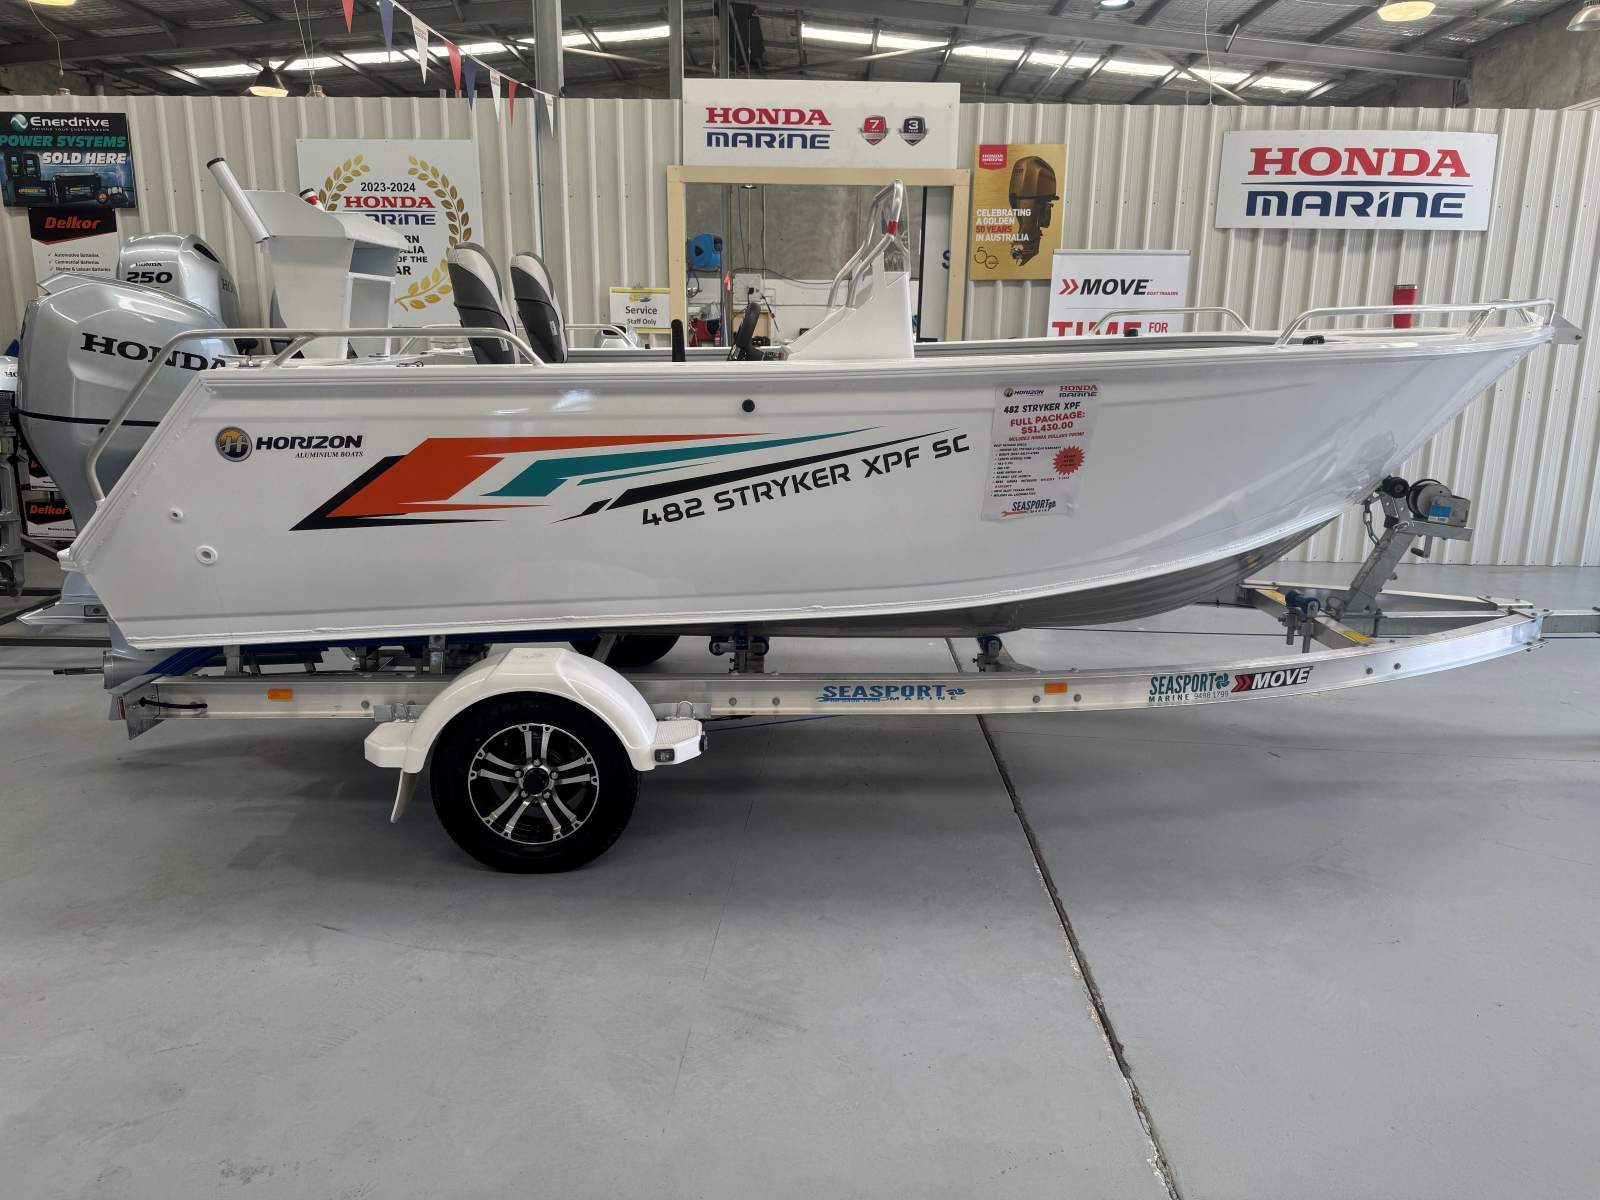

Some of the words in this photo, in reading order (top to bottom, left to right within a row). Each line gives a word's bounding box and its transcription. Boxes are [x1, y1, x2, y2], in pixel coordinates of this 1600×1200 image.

[30, 116, 110, 127] Enerdrive
[705, 107, 832, 126] HONDA
[869, 119, 880, 129] 7
[908, 120, 919, 130] 3
[0, 135, 53, 148] POWER
[56, 135, 126, 148] SYSTEMS
[707, 132, 830, 150] MARINE
[42, 152, 82, 165] SOLD
[85, 152, 127, 165] HERE
[1248, 147, 1470, 178] HONDA
[361, 182, 416, 193] 2023-2024
[344, 196, 436, 208] HONDA
[1246, 190, 1466, 219] MARINE
[976, 208, 1032, 217] CELEBRATING
[45, 216, 101, 230] Delkor
[976, 217, 982, 225] A
[983, 217, 1015, 225] GOLDEN
[976, 226, 985, 234] 50
[987, 226, 1012, 234] YEARS
[985, 233, 1029, 241] AUSTRALIA
[126, 271, 173, 284] 250
[1080, 278, 1149, 296] MOVE
[625, 305, 658, 315] Service
[642, 318, 657, 326] Only
[1148, 322, 1169, 334] FOR
[1059, 384, 1098, 392] HONDA
[1004, 405, 1019, 414] 482
[1022, 402, 1060, 413] STRYKER
[1063, 401, 1081, 410] XPF
[1010, 417, 1034, 428] FULL
[1035, 411, 1086, 425] PACKAGE:
[256, 435, 363, 450] HORIZON
[295, 451, 339, 459] ALUMINIUM
[642, 497, 704, 526] 482
[713, 462, 851, 512] STRYKER
[861, 446, 920, 479] XPF
[932, 434, 970, 459] SC
[30, 504, 68, 515] Delkor
[1012, 499, 1050, 512] SEASPORT
[1149, 673, 1217, 695] SEASPORT
[1251, 668, 1310, 690] MOVE
[823, 685, 946, 698] SEASPORT
[1148, 694, 1190, 703] MARINE
